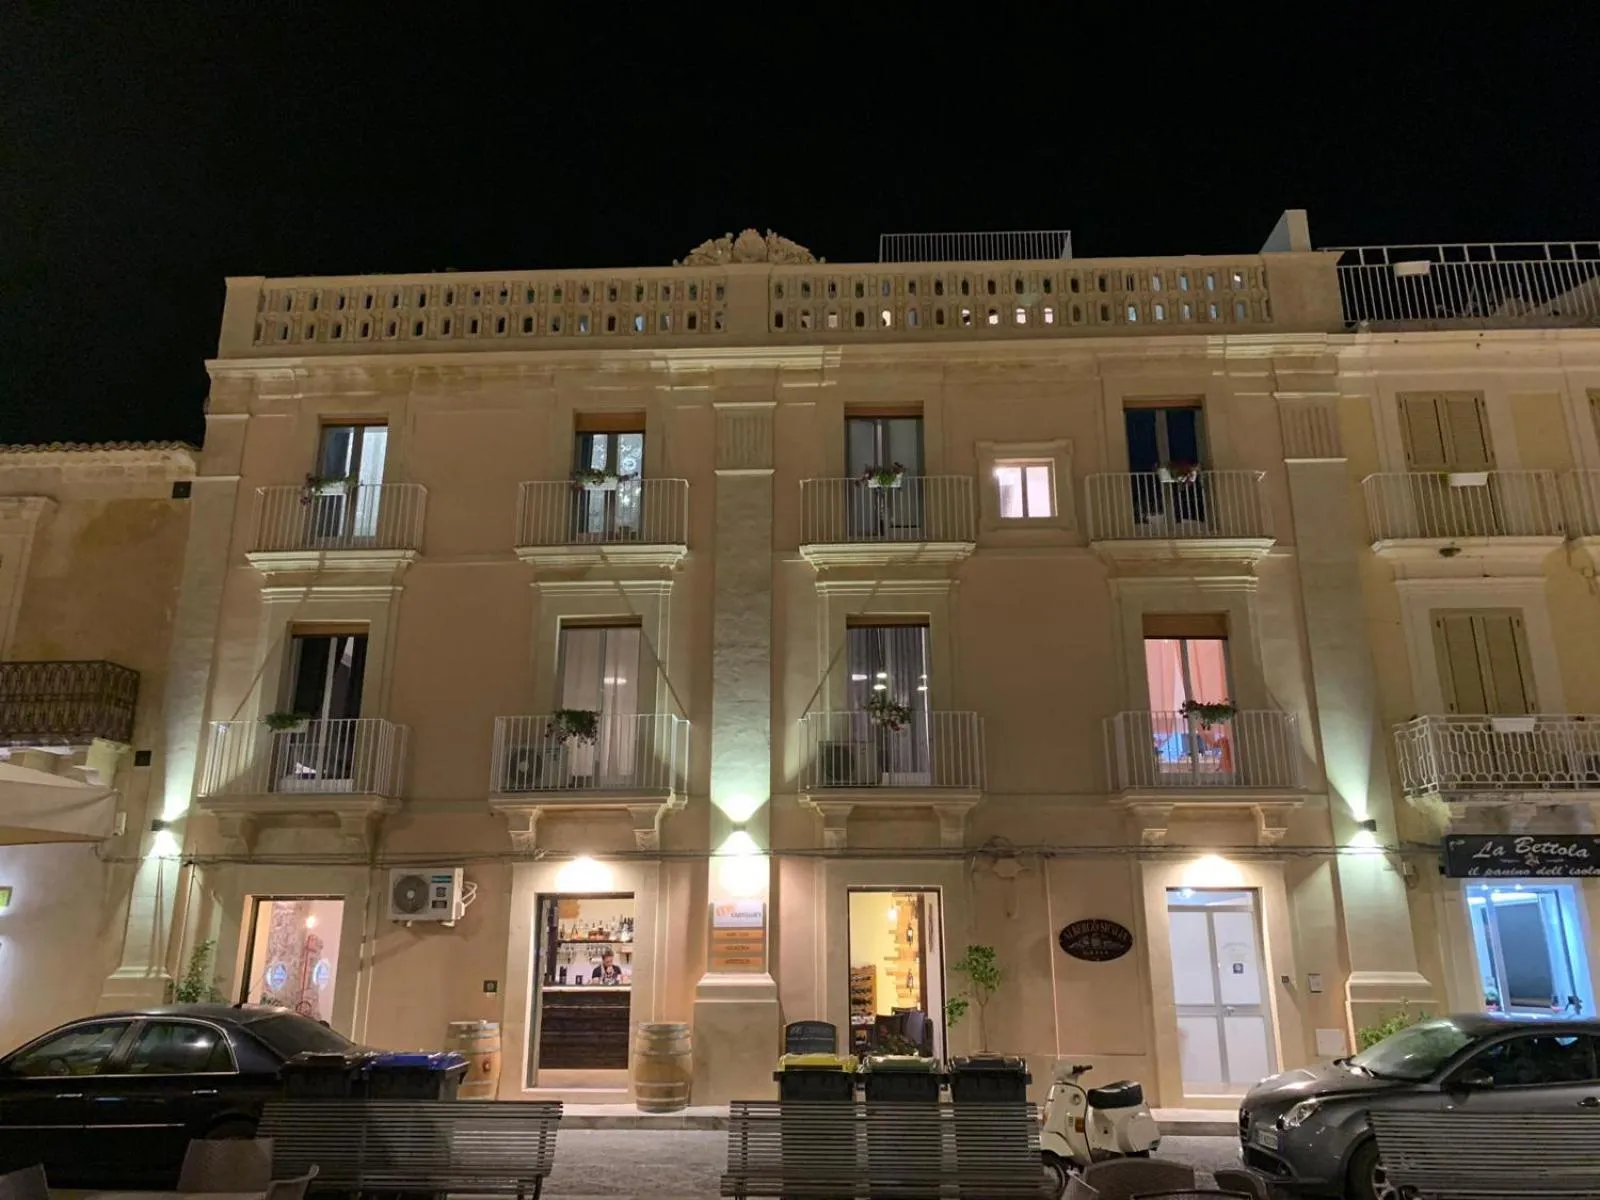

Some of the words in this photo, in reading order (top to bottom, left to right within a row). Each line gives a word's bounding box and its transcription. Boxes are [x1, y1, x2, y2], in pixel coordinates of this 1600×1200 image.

[1472, 841, 1506, 859] La
[1514, 836, 1590, 859] Bettola
[1467, 866, 1480, 877] il
[1483, 867, 1530, 878] panino
